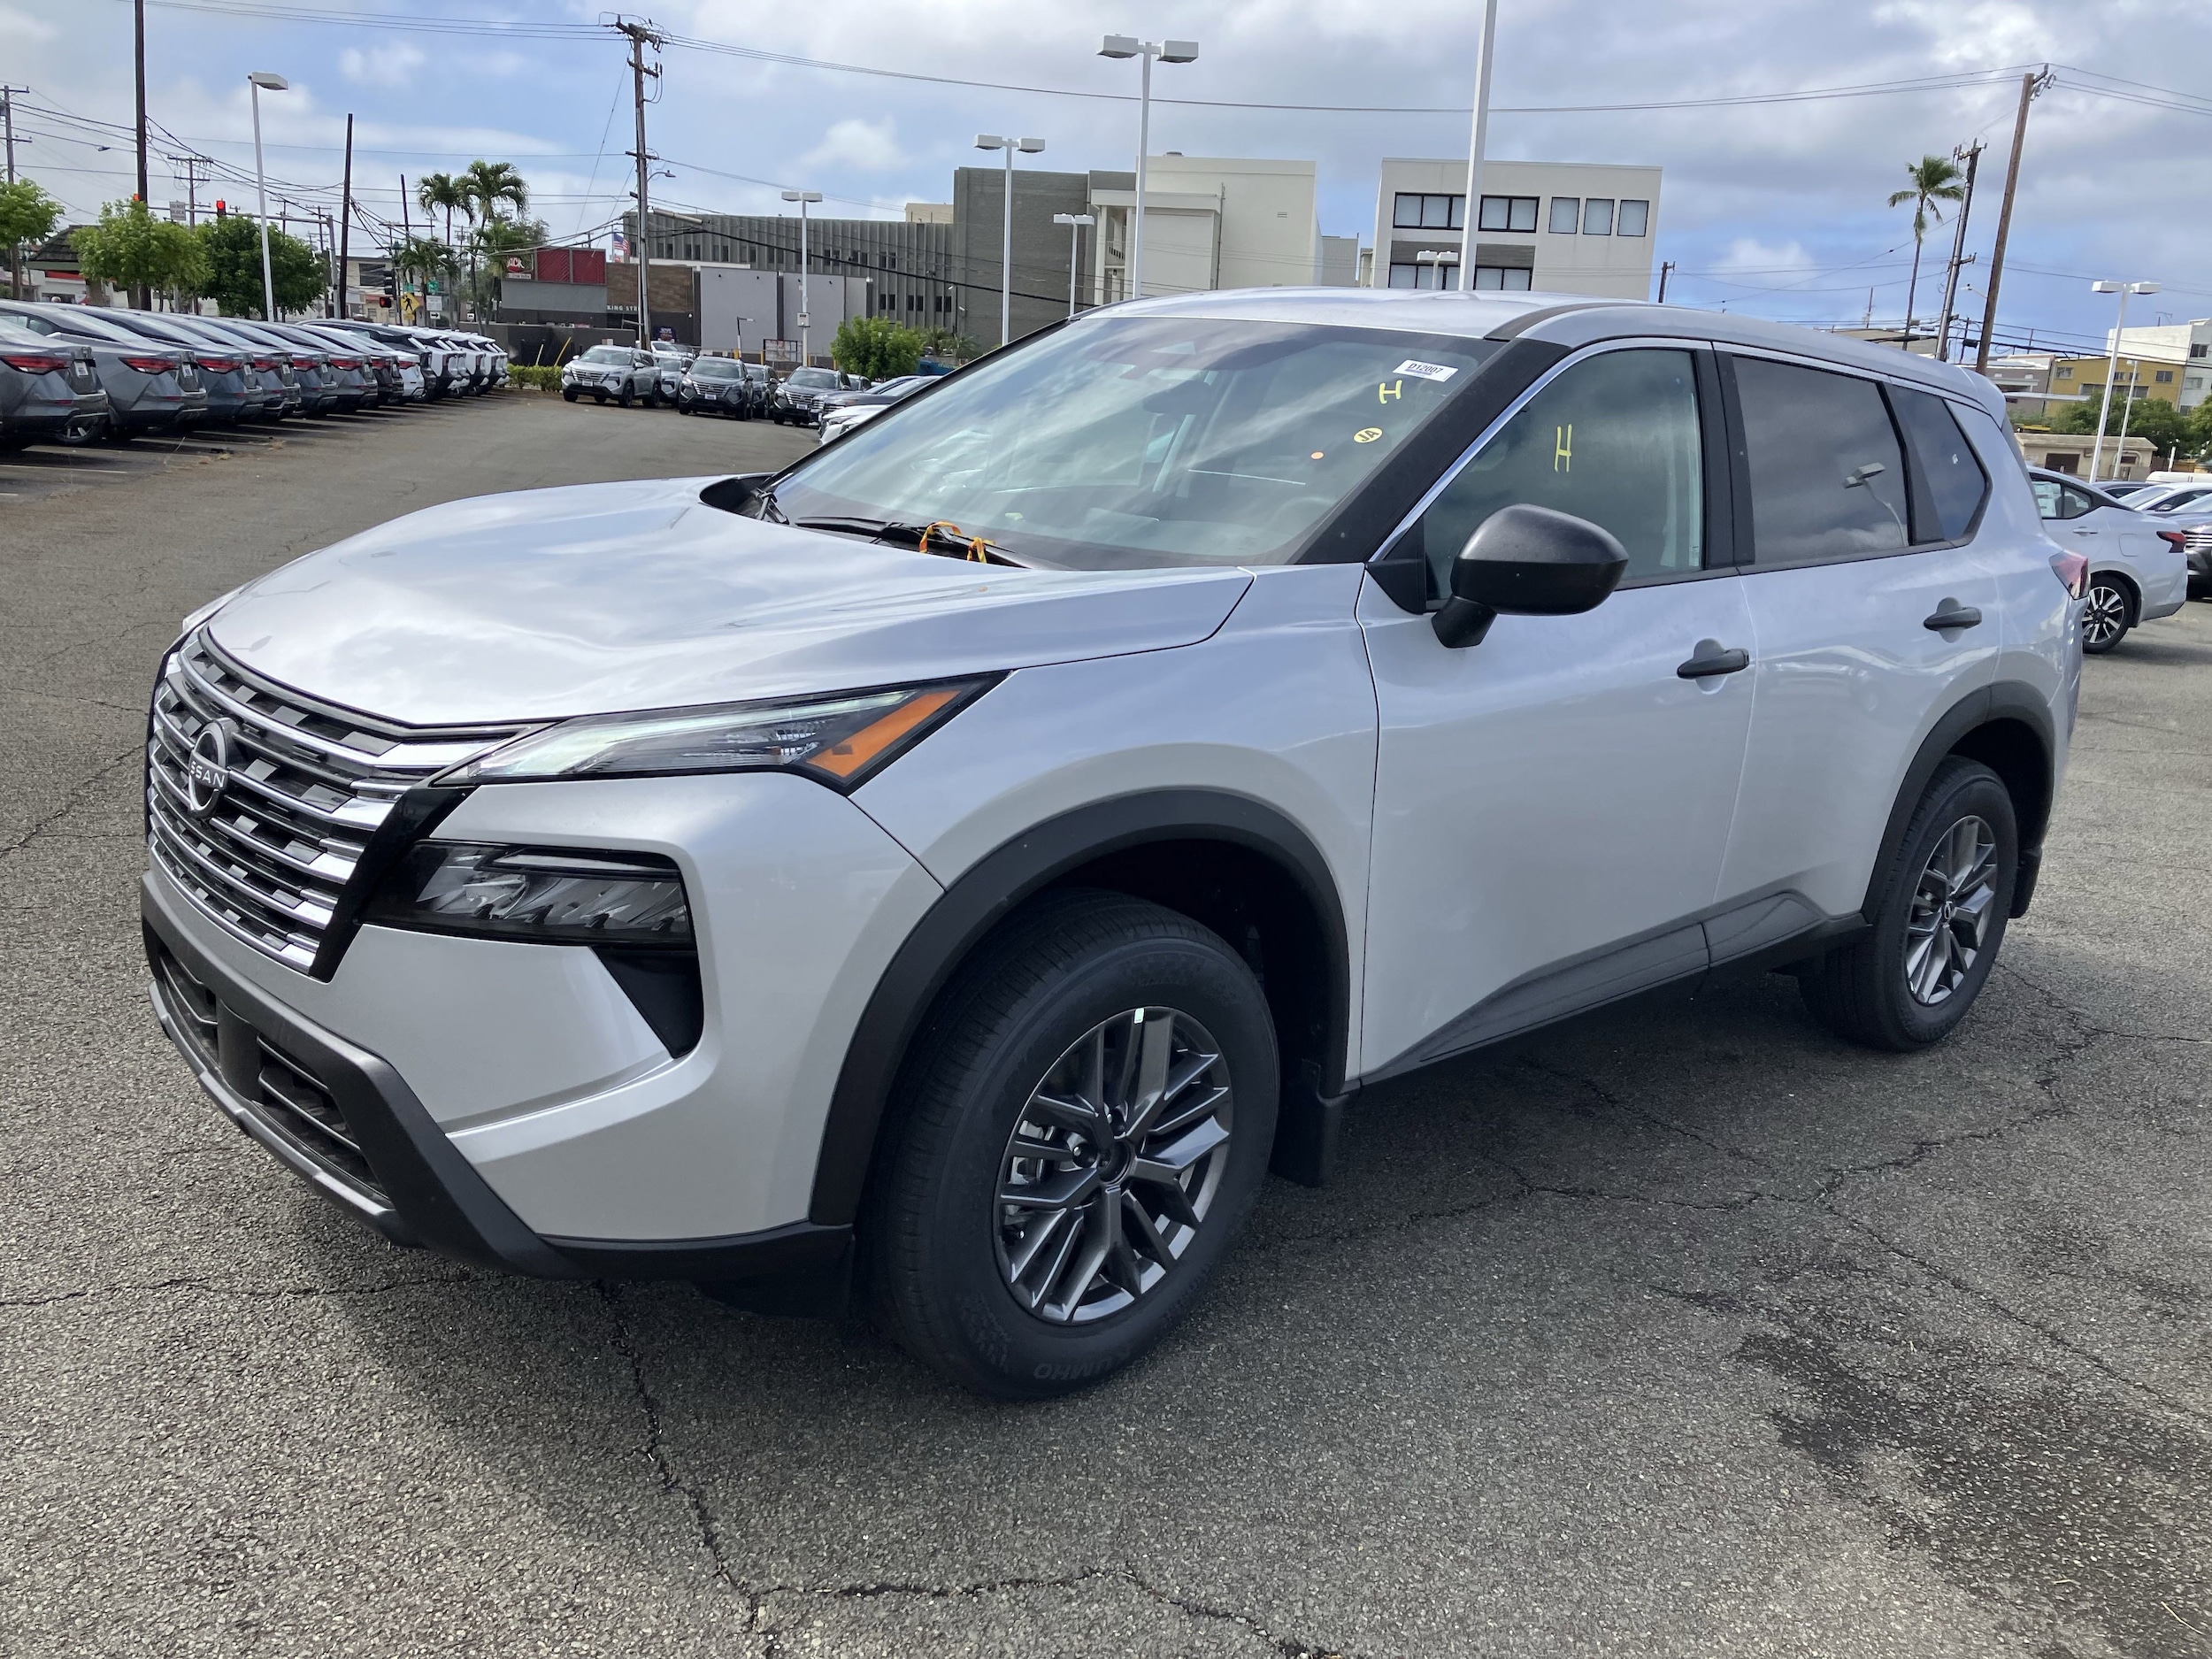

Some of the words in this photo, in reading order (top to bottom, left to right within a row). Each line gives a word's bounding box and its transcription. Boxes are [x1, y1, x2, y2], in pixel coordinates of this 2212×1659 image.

[1379, 380, 1403, 404] H
[1357, 430, 1380, 442] JA
[1555, 424, 1572, 472] H
